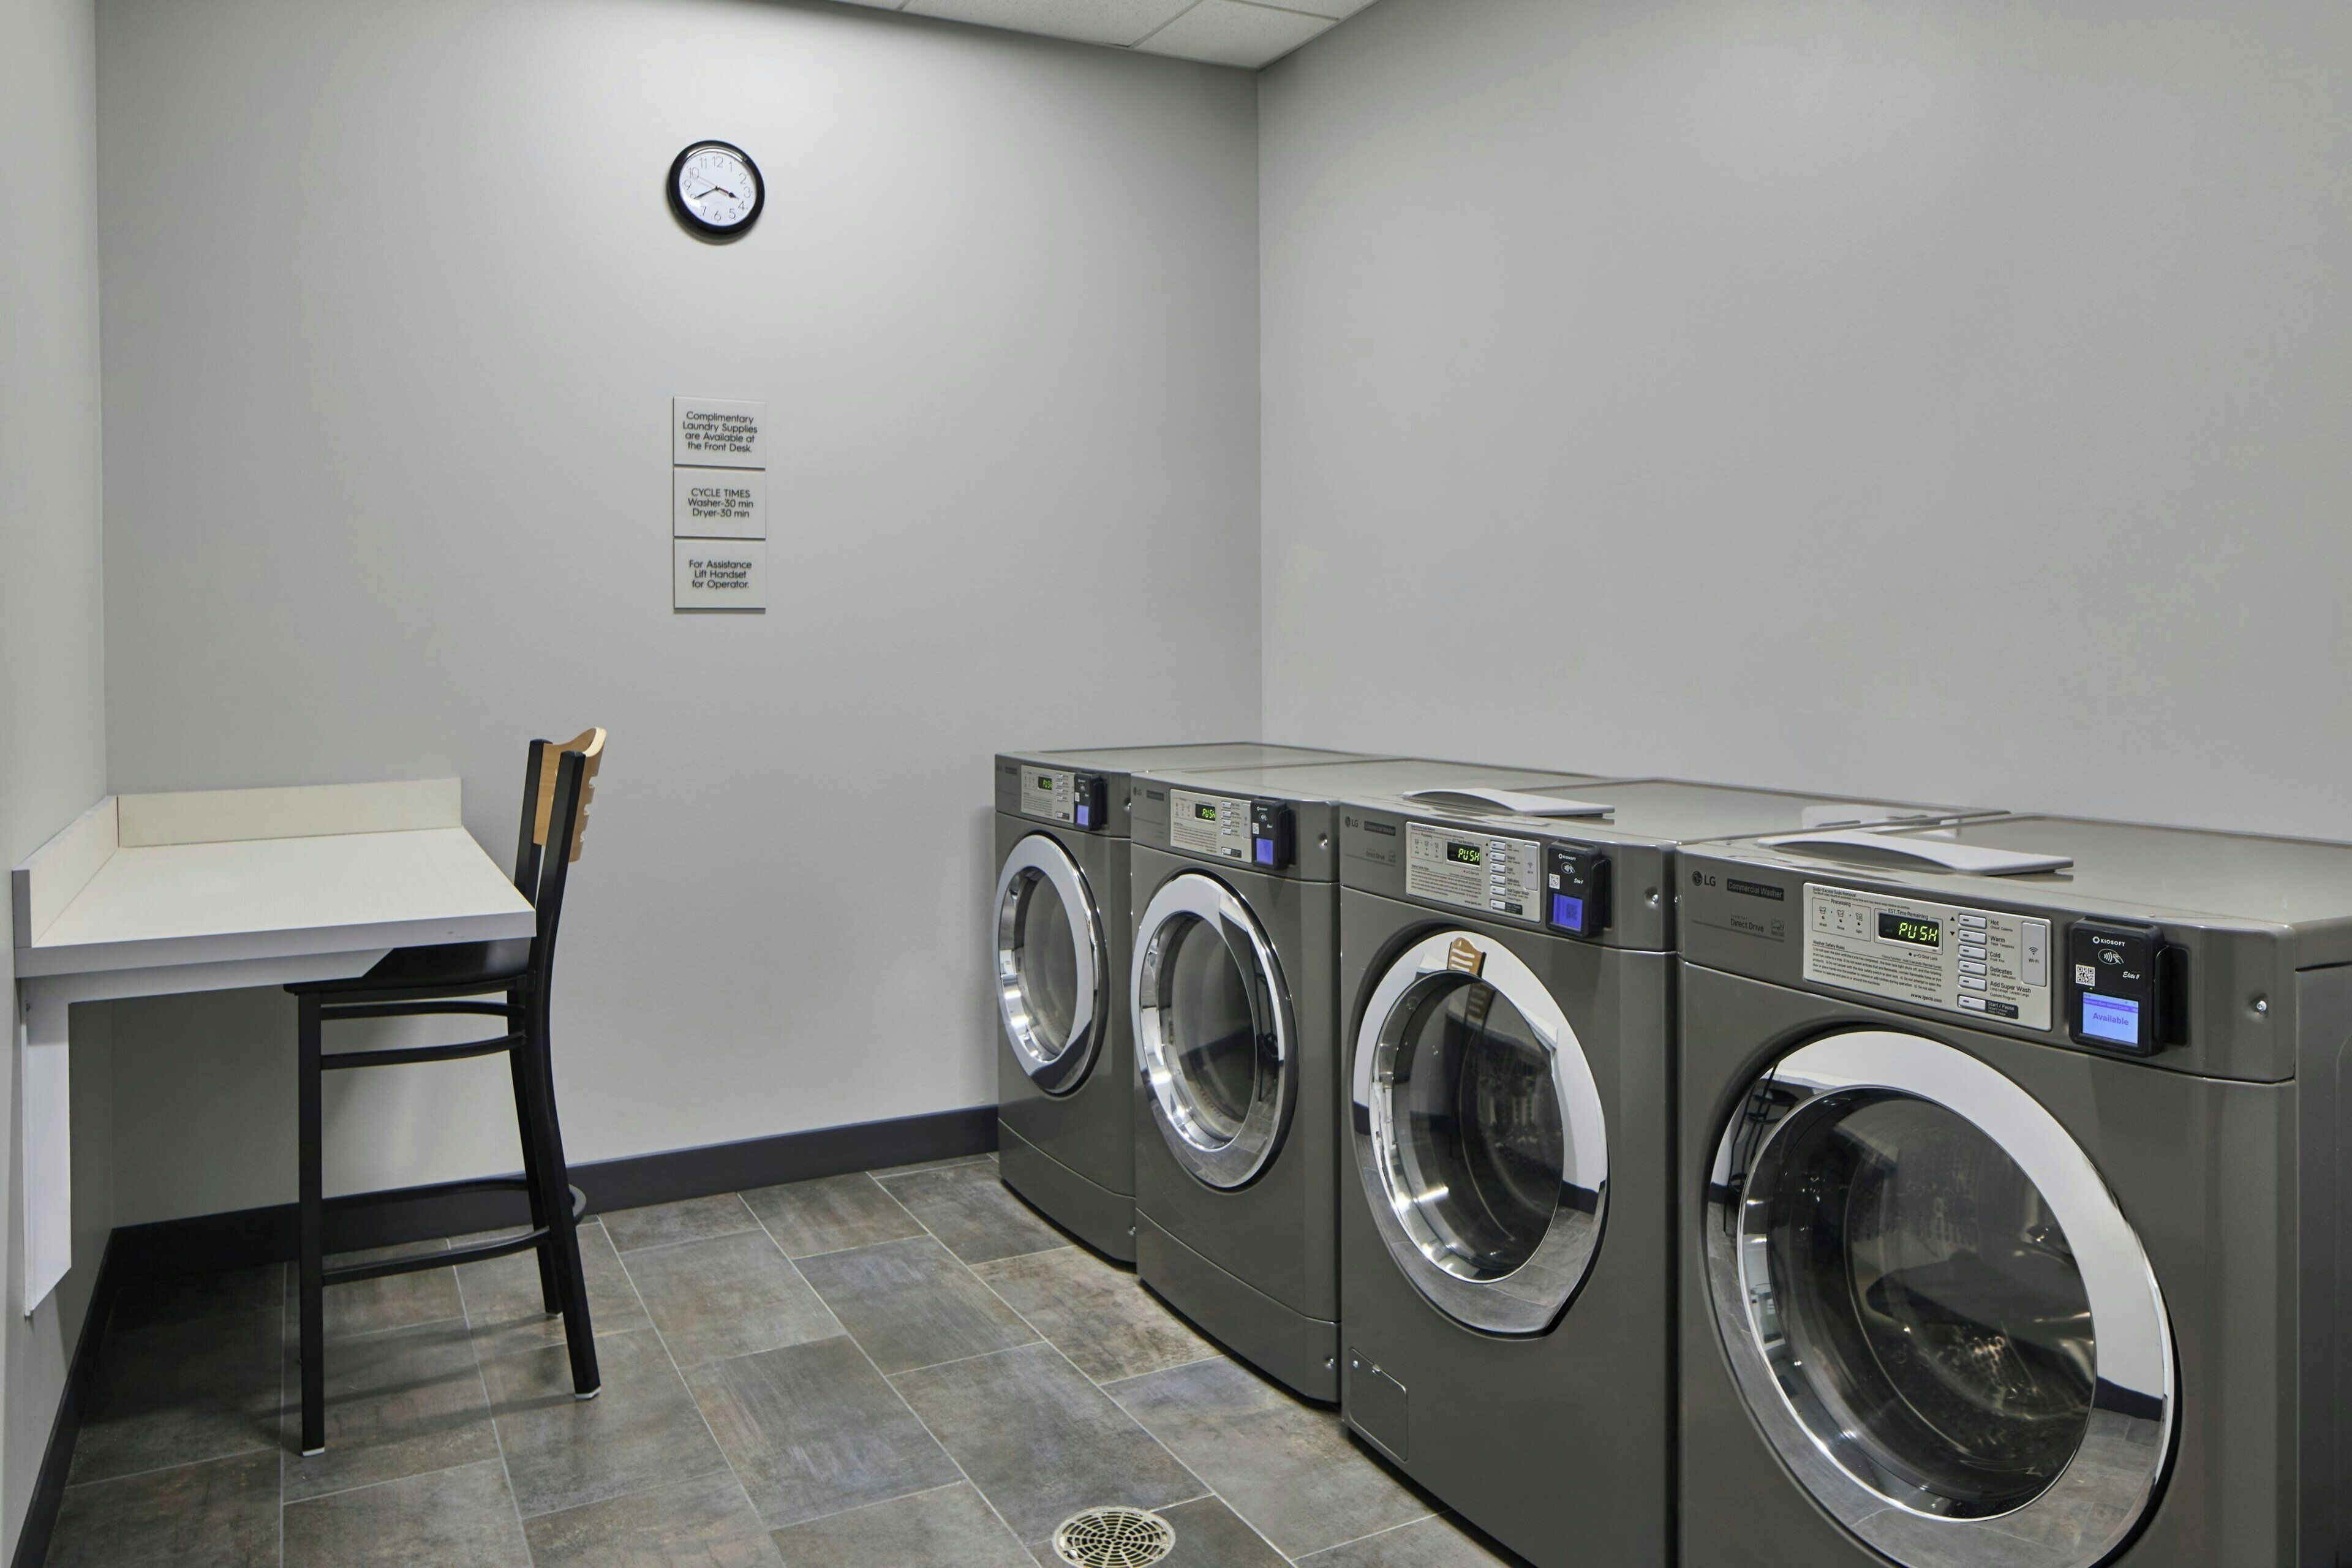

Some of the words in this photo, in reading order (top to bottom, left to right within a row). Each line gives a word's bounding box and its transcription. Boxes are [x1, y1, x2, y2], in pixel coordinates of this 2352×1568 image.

[699, 157, 707, 169] 11
[712, 156, 724, 168] 12
[728, 162, 733, 172] 1
[687, 167, 699, 179] 10
[739, 173, 746, 184] 2
[684, 179, 692, 190] 9
[744, 186, 751, 198] 3
[701, 206, 707, 216] 7
[738, 201, 745, 211] 4
[714, 210, 722, 221] 6
[729, 208, 735, 219] 5
[686, 410, 753, 425] Complimentary
[682, 421, 719, 432] Laundry
[722, 423, 758, 434] Supplies
[703, 432, 743, 443] Available
[688, 441, 701, 450] the
[704, 442, 726, 451] Front
[729, 443, 752, 453] Desk.
[691, 488, 720, 497] CYCLE
[724, 489, 750, 499] TIMES
[688, 498, 735, 507] Washer-30
[692, 508, 731, 519] Dryer-30
[689, 560, 703, 568] For
[707, 560, 752, 568] Assistance
[692, 579, 704, 588] for
[707, 579, 749, 590] Operator.
[1351, 818, 1359, 827] LG
[1458, 848, 1480, 861] PUSH
[1704, 875, 1716, 887] LG
[1728, 881, 1760, 894] Commercial
[1760, 888, 1782, 898] Washer
[1831, 899, 1851, 907] Processing
[1907, 911, 1928, 920] Remaining
[1730, 918, 1747, 929] Direct
[1749, 922, 1764, 932] Drive
[1899, 922, 1938, 942] PUSH
[1990, 967, 2013, 975] Delicates
[2093, 1012, 2129, 1025] Available
